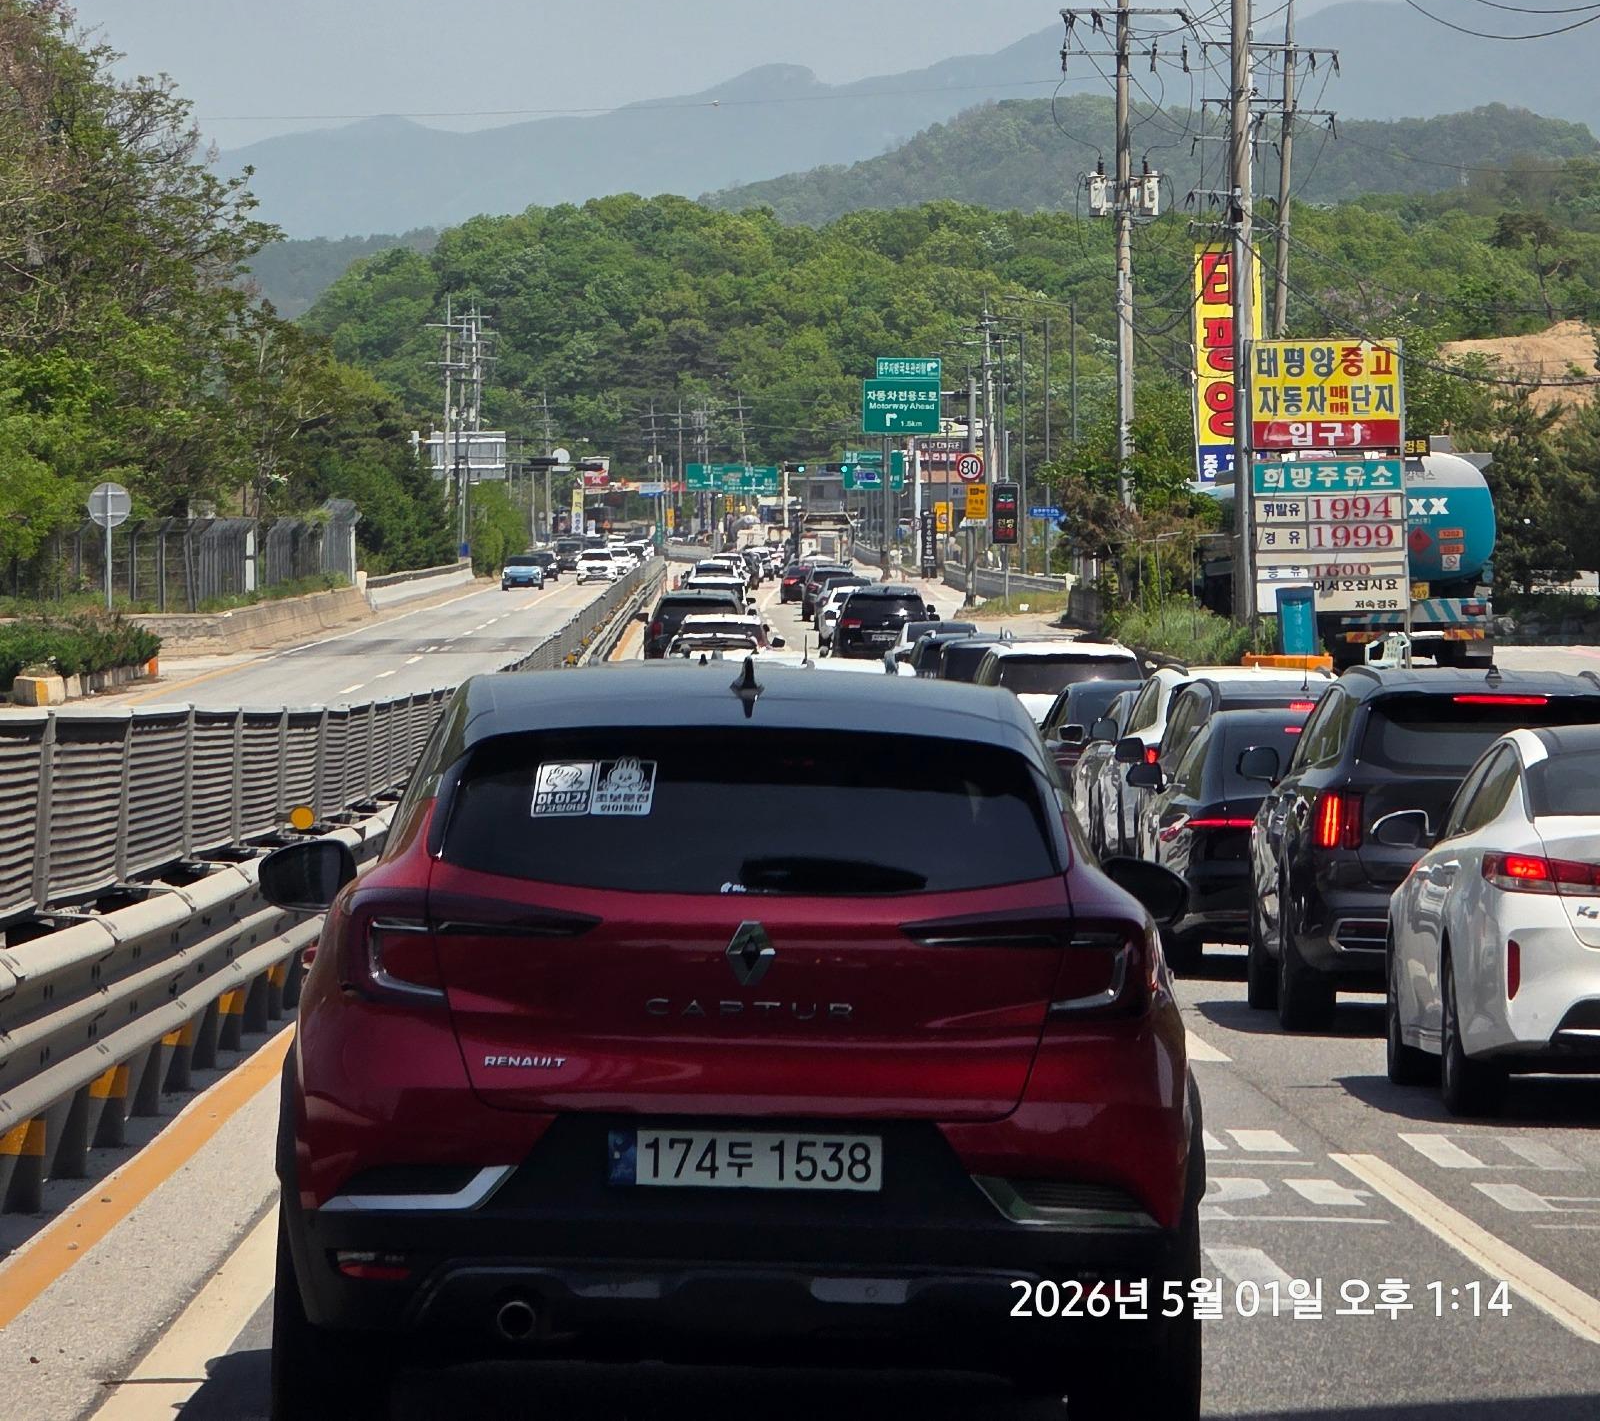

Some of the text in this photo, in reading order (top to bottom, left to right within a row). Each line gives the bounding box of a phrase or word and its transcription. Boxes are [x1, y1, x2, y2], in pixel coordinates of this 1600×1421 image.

[1256, 346, 1393, 377] 태평양중고
[867, 390, 938, 402] 자동차전용도로
[869, 402, 935, 411] Motorway Ahead
[1289, 422, 1344, 446] 입구
[960, 460, 979, 475] 80
[1263, 465, 1394, 488] 희망주유소
[1263, 496, 1393, 520] 휘발유 1994
[1312, 524, 1394, 547] 1999
[1314, 563, 1372, 577] 1600
[1313, 579, 1398, 591] 어서오십시요
[537, 791, 587, 804] 아이가
[646, 998, 852, 1019] CAPTUR
[484, 1056, 566, 1067] RENAULT
[645, 1137, 872, 1183] 174두 1538
